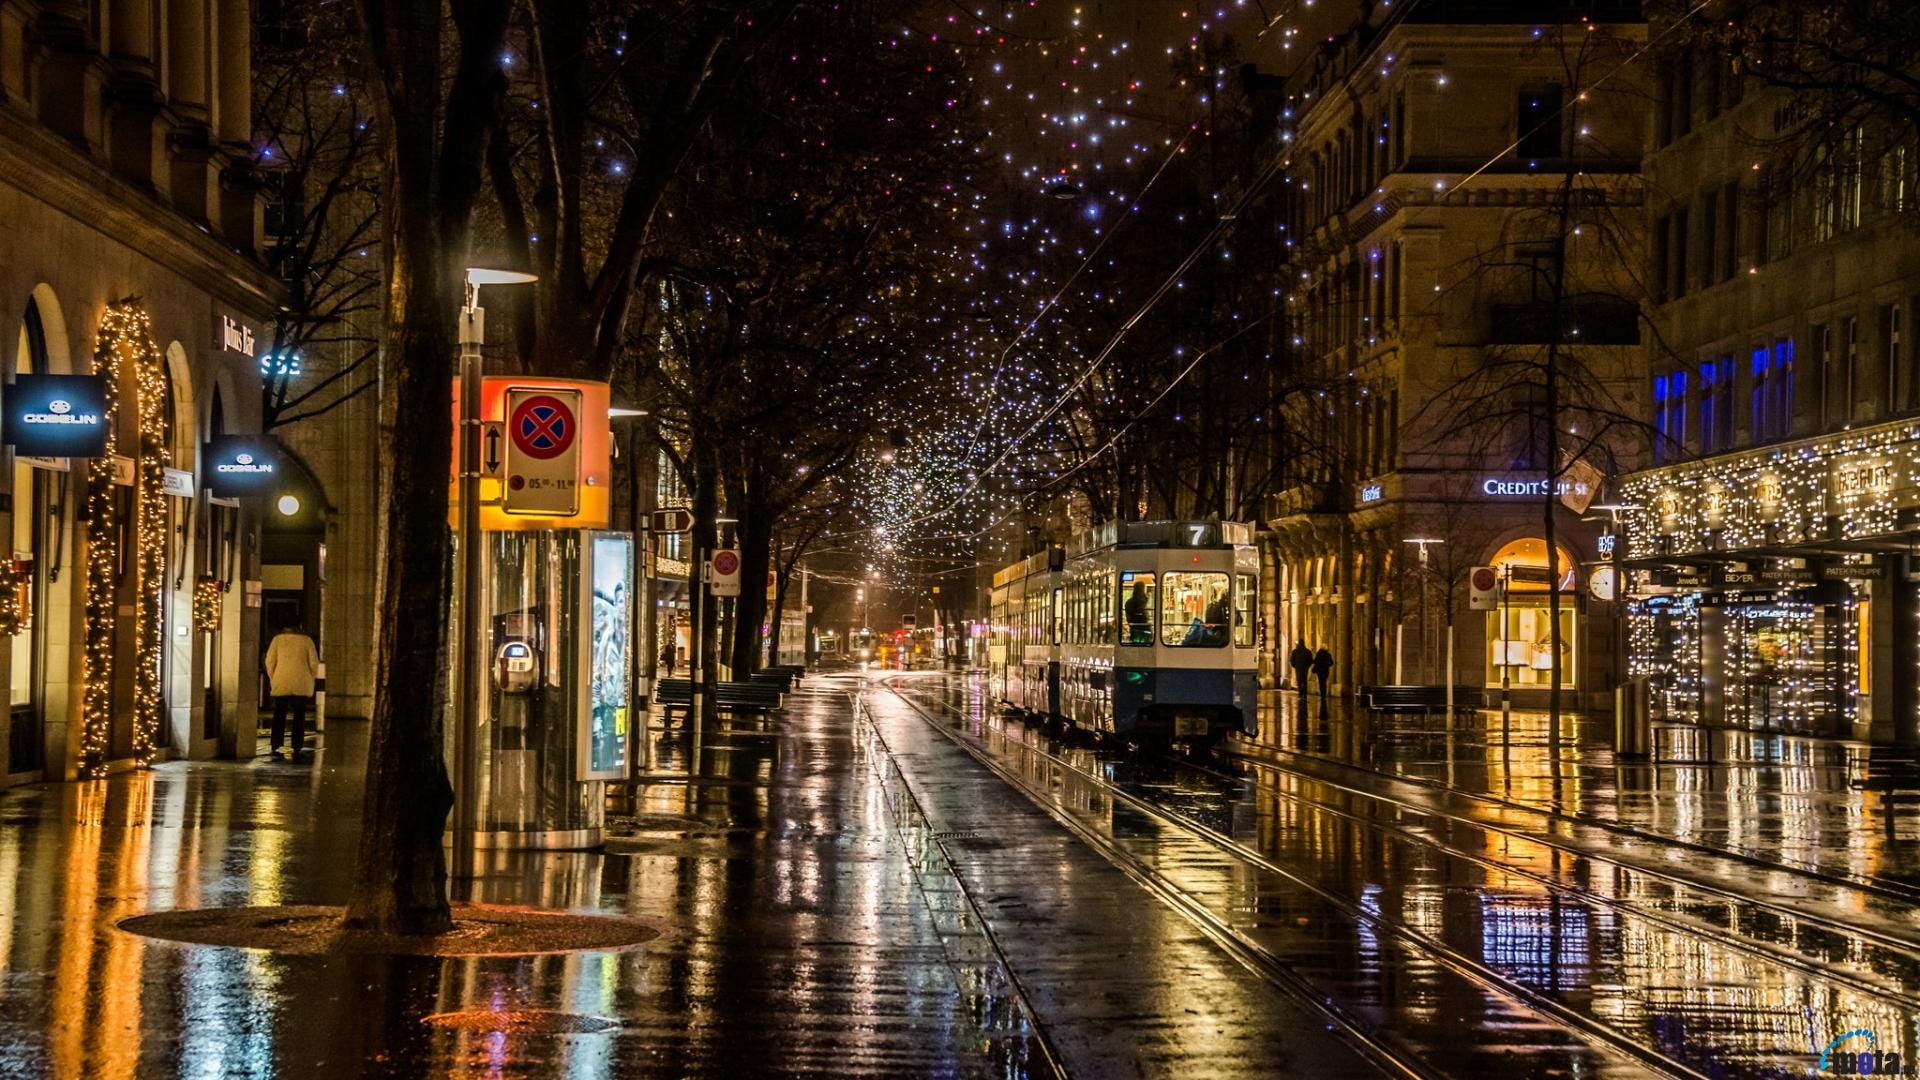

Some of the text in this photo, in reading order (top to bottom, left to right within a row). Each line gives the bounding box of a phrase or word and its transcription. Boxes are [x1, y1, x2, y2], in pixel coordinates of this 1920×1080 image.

[1483, 479, 1539, 495] CREDIT
[1189, 525, 1205, 545] 7
[1725, 574, 1753, 583] BEYER
